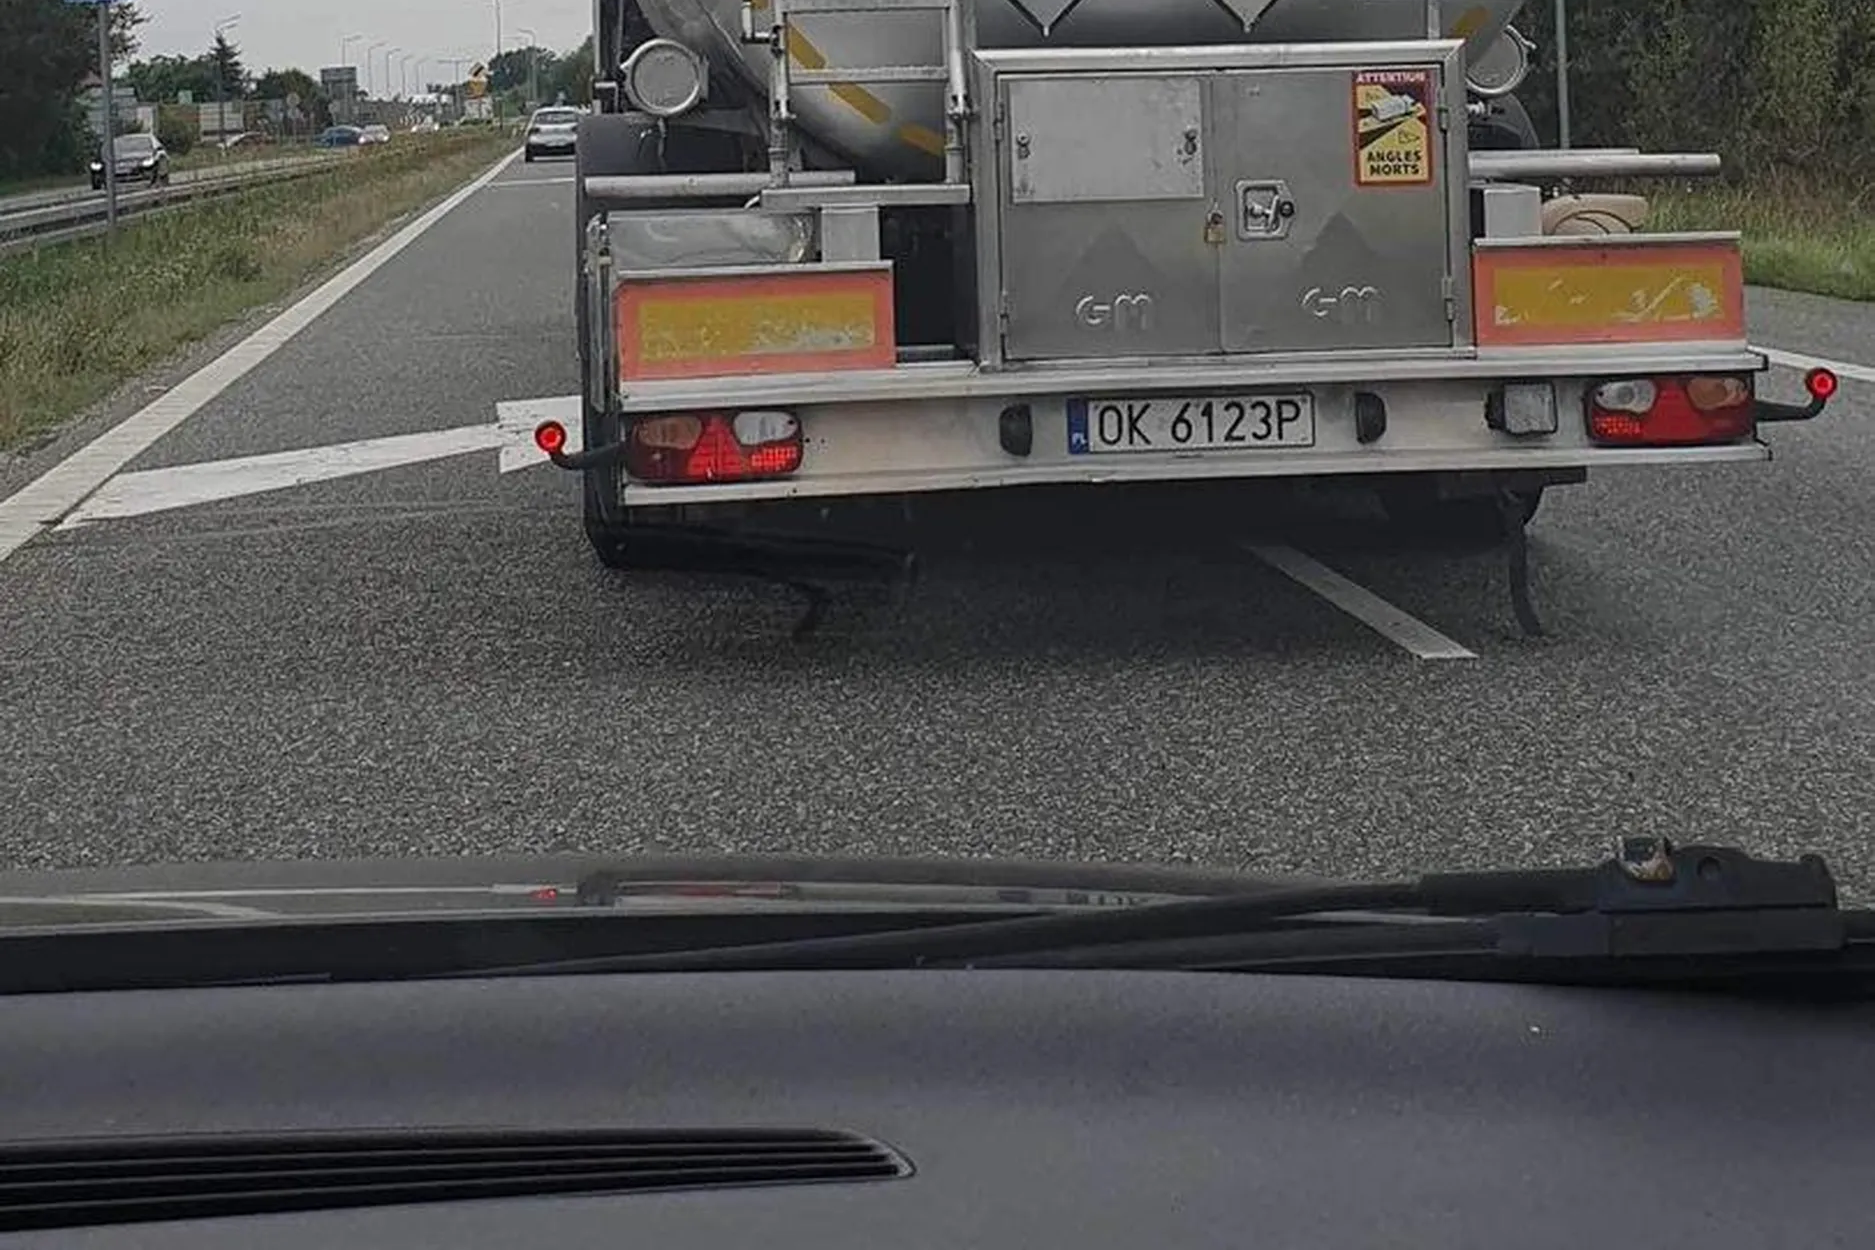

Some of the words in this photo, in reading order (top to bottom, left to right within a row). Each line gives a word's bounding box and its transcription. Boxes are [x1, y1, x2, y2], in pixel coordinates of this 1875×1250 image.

[1367, 150, 1422, 163] ANGLES
[1369, 164, 1420, 176] MORTS
[1099, 403, 1152, 446] OK
[1171, 399, 1301, 443] 6123P
